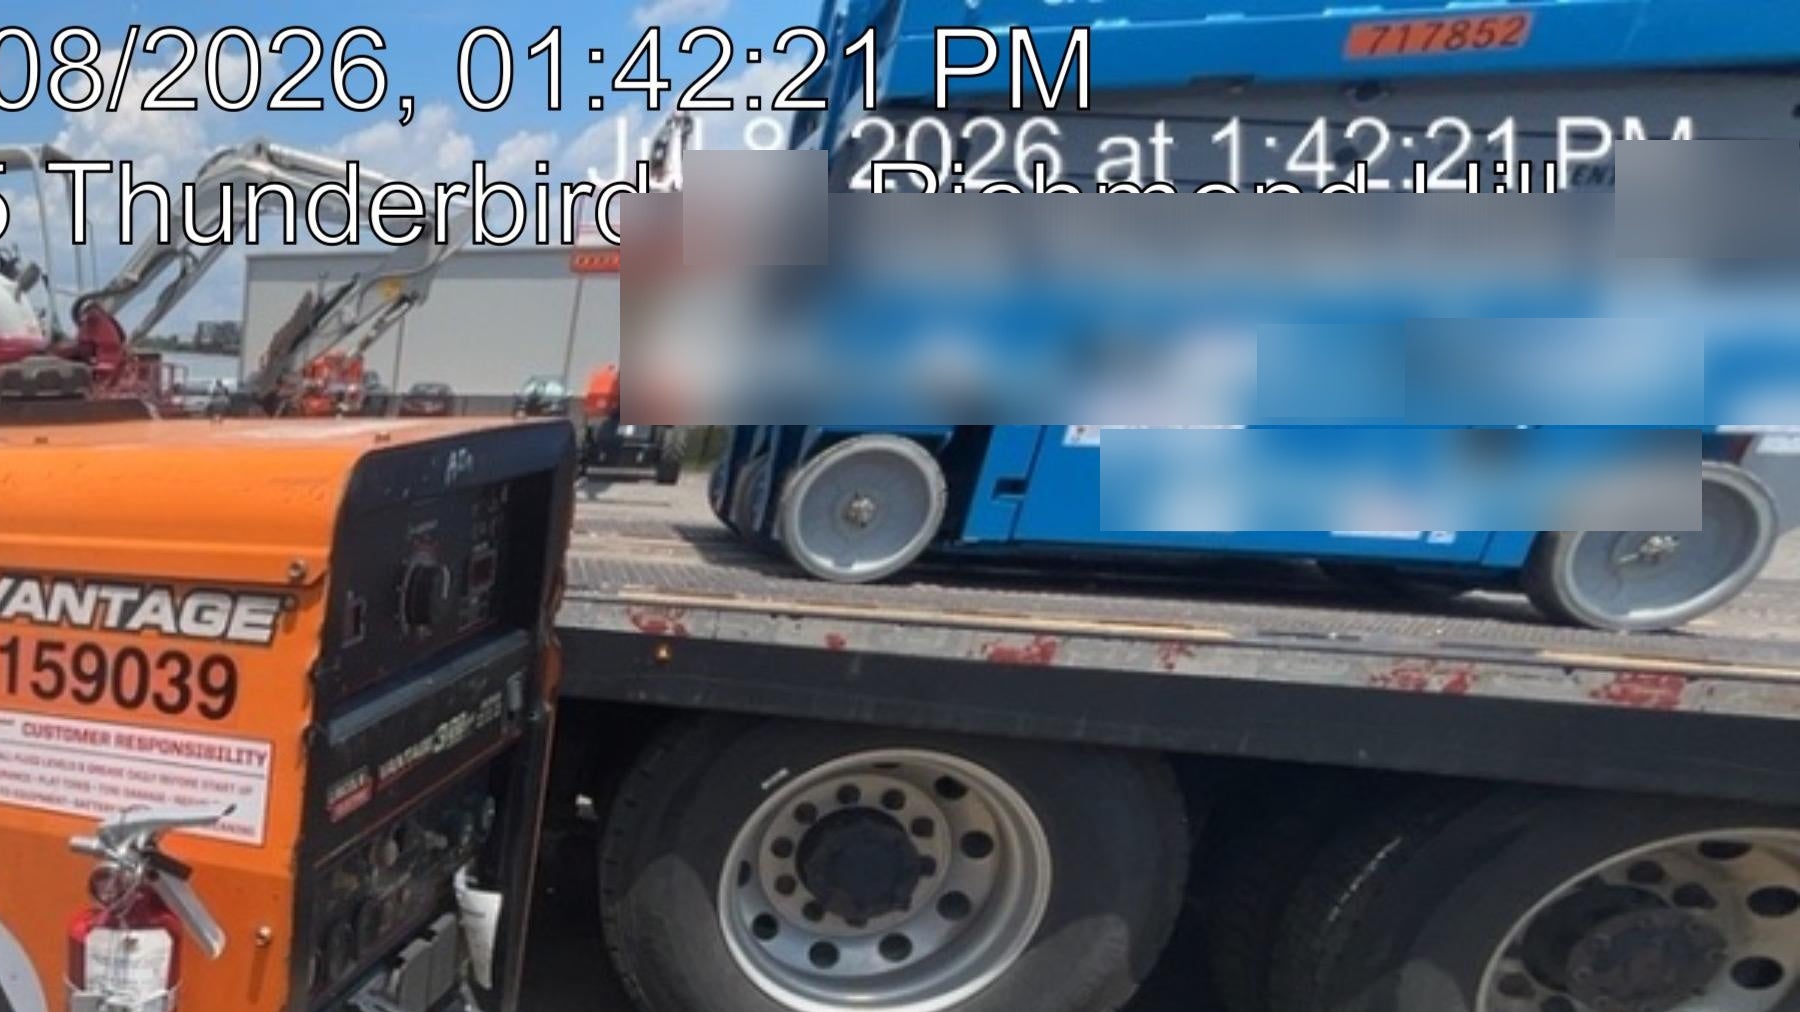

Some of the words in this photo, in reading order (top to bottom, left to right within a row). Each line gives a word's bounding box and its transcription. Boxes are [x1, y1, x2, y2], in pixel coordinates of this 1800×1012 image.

[1368, 15, 1527, 56] 717852
[21, 720, 112, 746] CUSTOMER
[114, 730, 269, 767] RESPONSIBILITY
